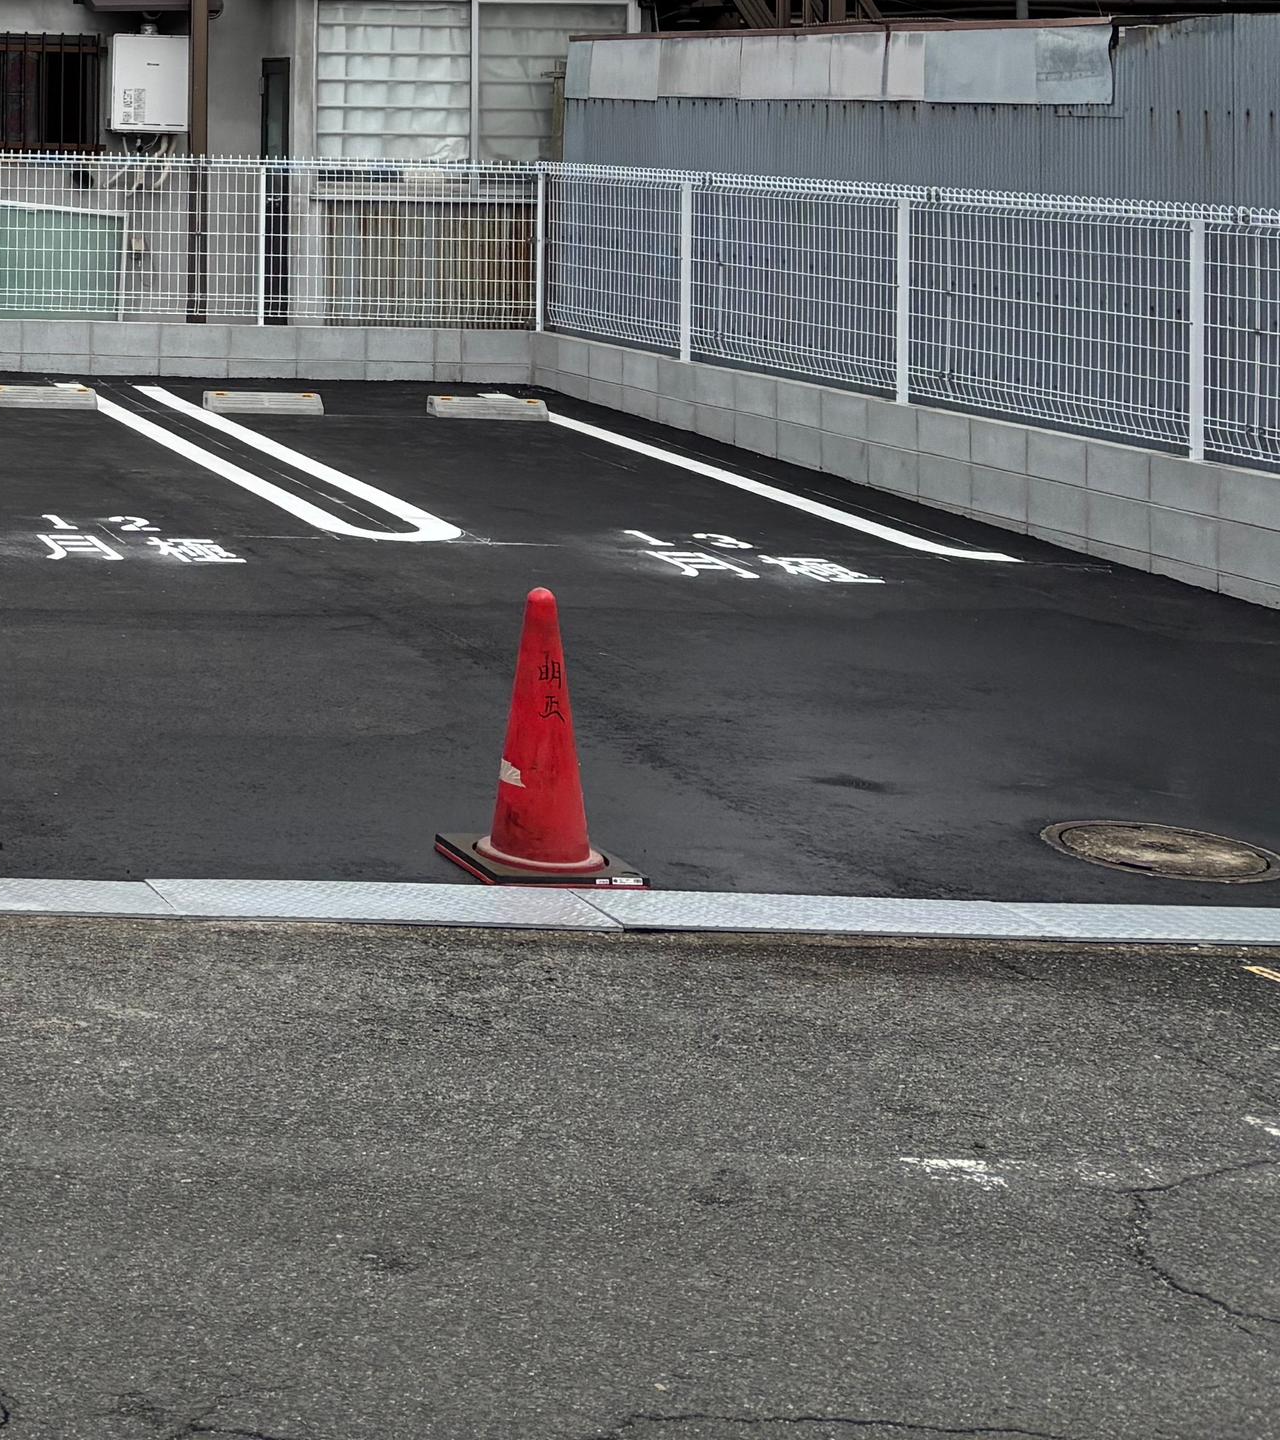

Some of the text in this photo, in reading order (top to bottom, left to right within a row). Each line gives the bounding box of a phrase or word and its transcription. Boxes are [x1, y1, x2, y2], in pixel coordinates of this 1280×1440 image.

[41, 514, 161, 531] 12
[36, 534, 247, 563] 月極
[623, 530, 755, 549] 13
[642, 550, 886, 583] 月極
[538, 652, 565, 723] 明正
